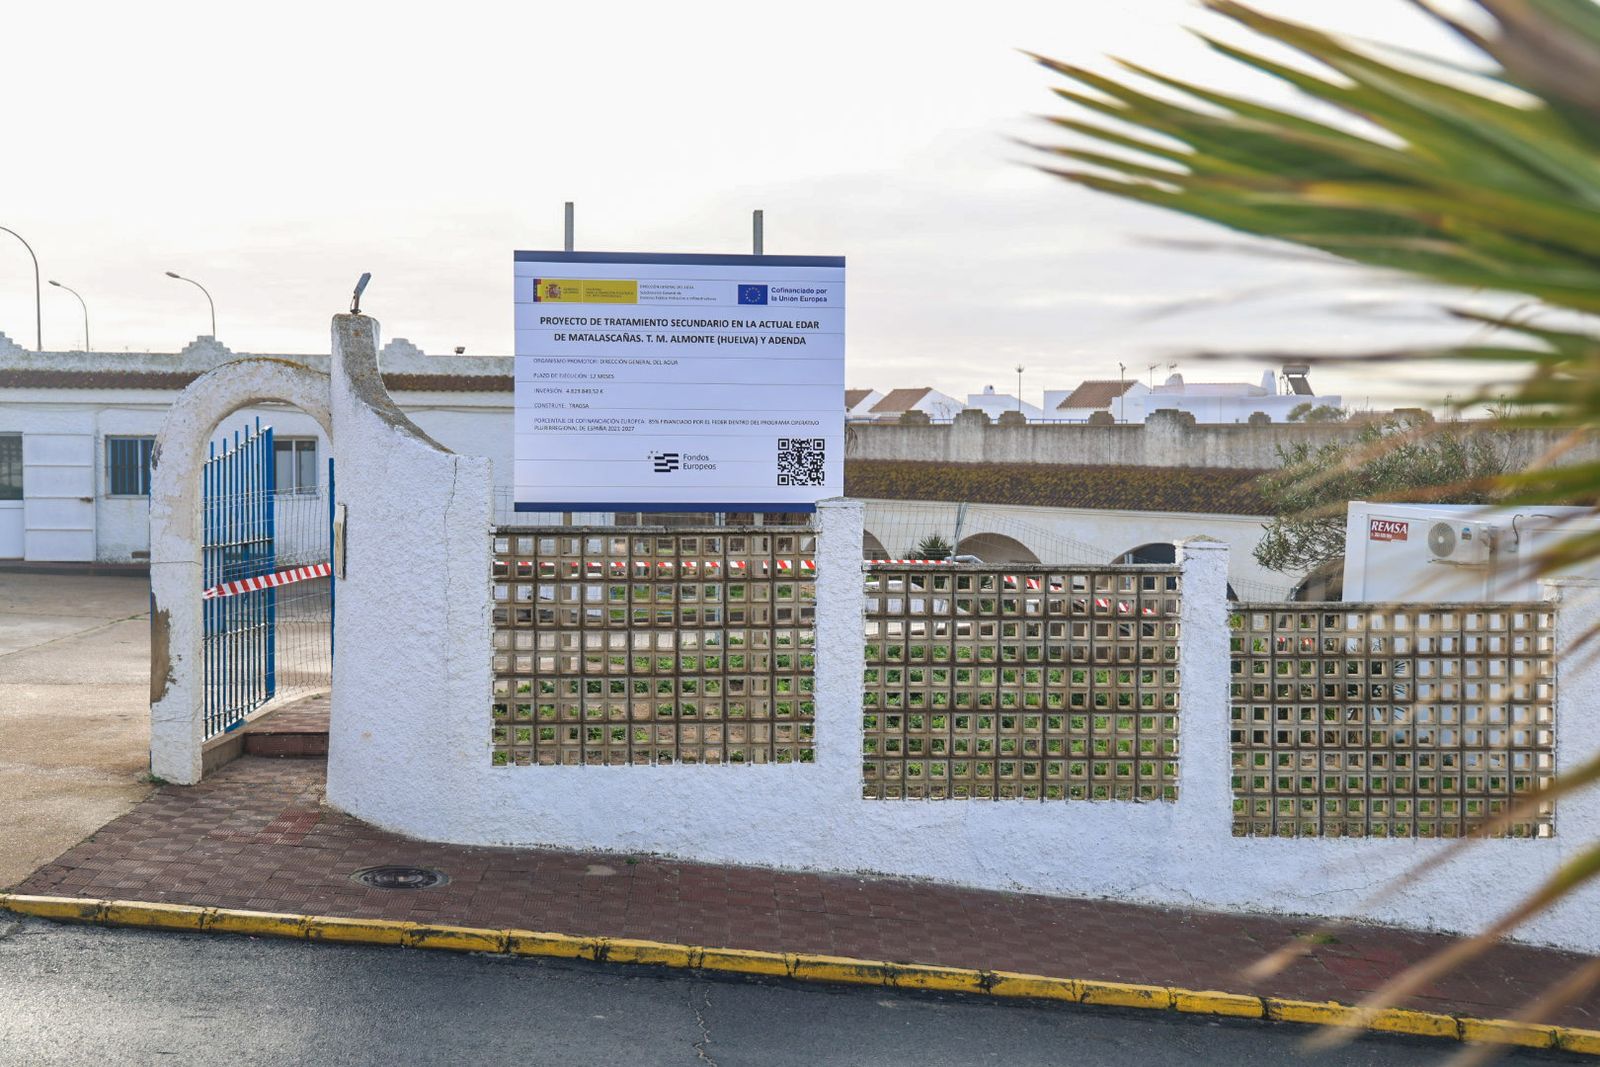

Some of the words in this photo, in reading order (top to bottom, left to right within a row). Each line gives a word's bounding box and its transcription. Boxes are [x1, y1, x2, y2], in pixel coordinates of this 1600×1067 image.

[540, 316, 587, 325] PROYECTO
[604, 318, 668, 327] TRATAMIENTO
[671, 319, 729, 328] SECUNDARIO
[796, 321, 819, 329] EDAR
[569, 333, 644, 342] MATALASCAÑAS.
[656, 334, 667, 343] M.
[670, 335, 714, 343] ALMONTE
[717, 335, 758, 345] (HUELVA)
[768, 336, 806, 344] ADENDA
[683, 462, 716, 471] Europeos
[1371, 520, 1408, 534] REMSA
